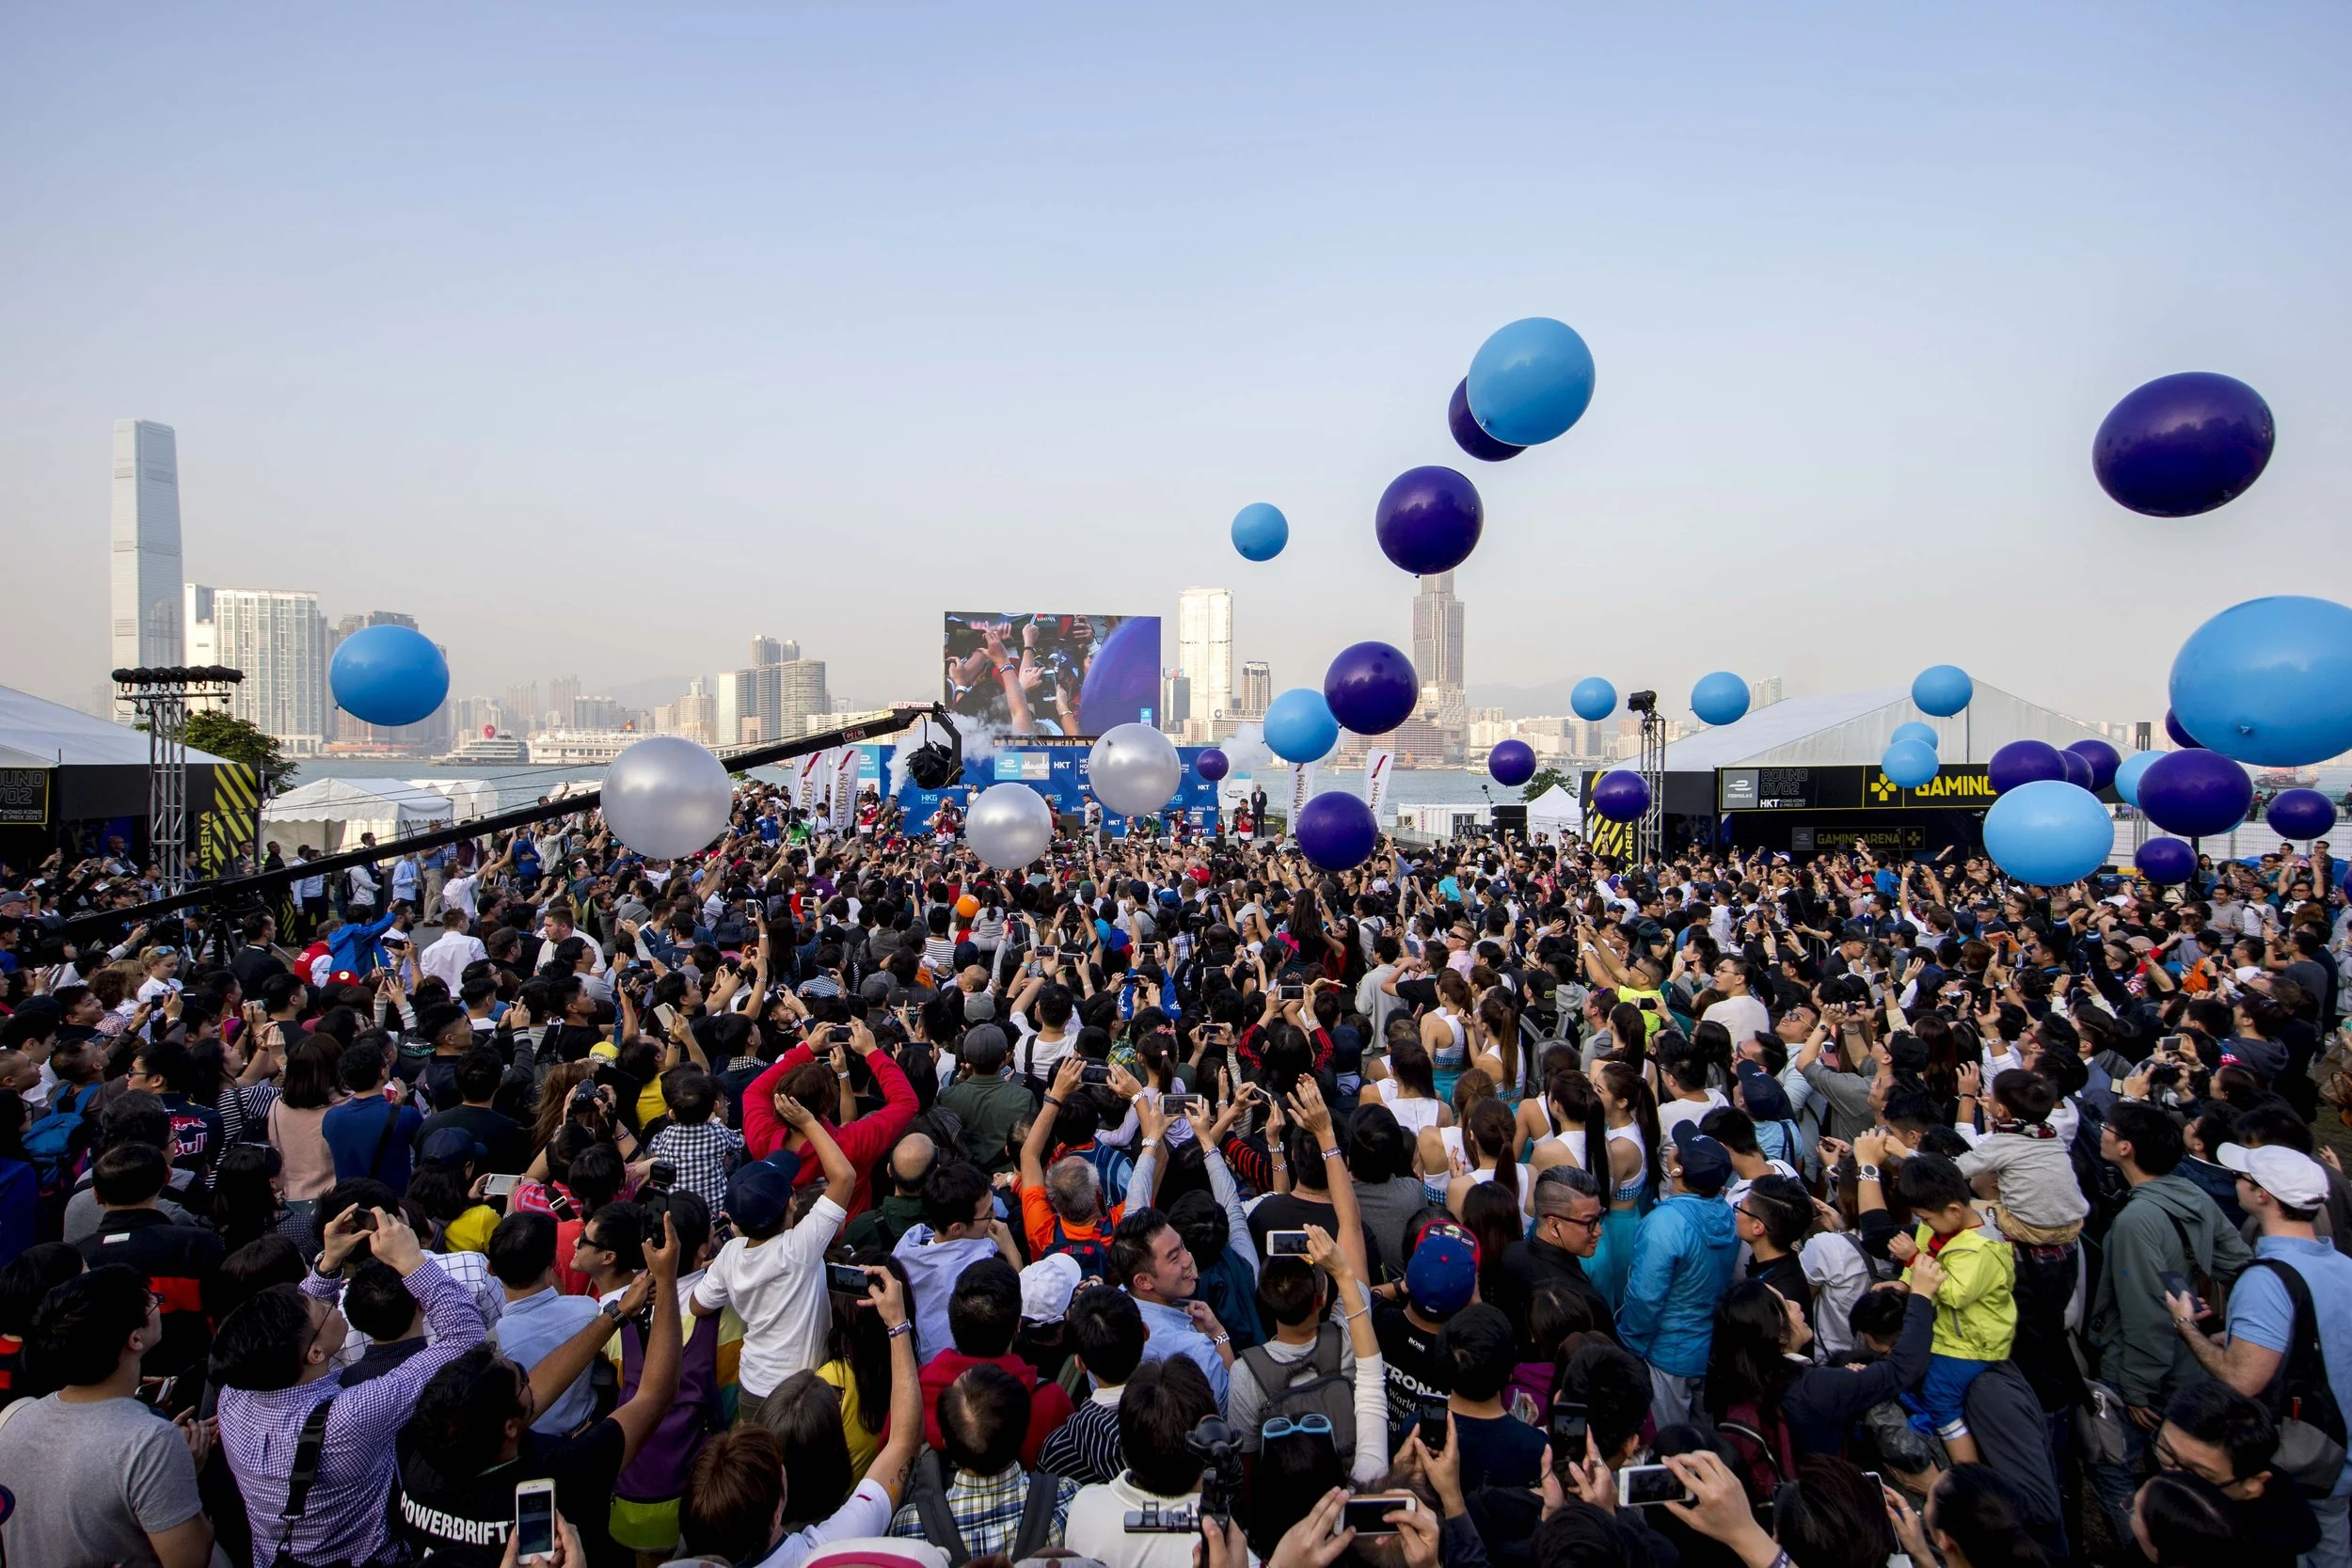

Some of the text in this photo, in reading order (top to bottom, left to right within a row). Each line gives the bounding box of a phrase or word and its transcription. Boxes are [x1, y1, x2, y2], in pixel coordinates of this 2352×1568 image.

[844, 728, 864, 740] CTC
[0, 770, 45, 787] UND
[1761, 768, 1808, 782] ROUND
[1760, 783, 1800, 796] 01/02
[1759, 799, 1779, 808] HKT
[200, 811, 212, 870] ARENA
[1625, 821, 1634, 861] AREN
[1864, 833, 1899, 844] ARENA
[1408, 1336, 1426, 1352] BOSS
[1389, 1386, 1417, 1414] World
[400, 1489, 509, 1545] POWERDRIFT
